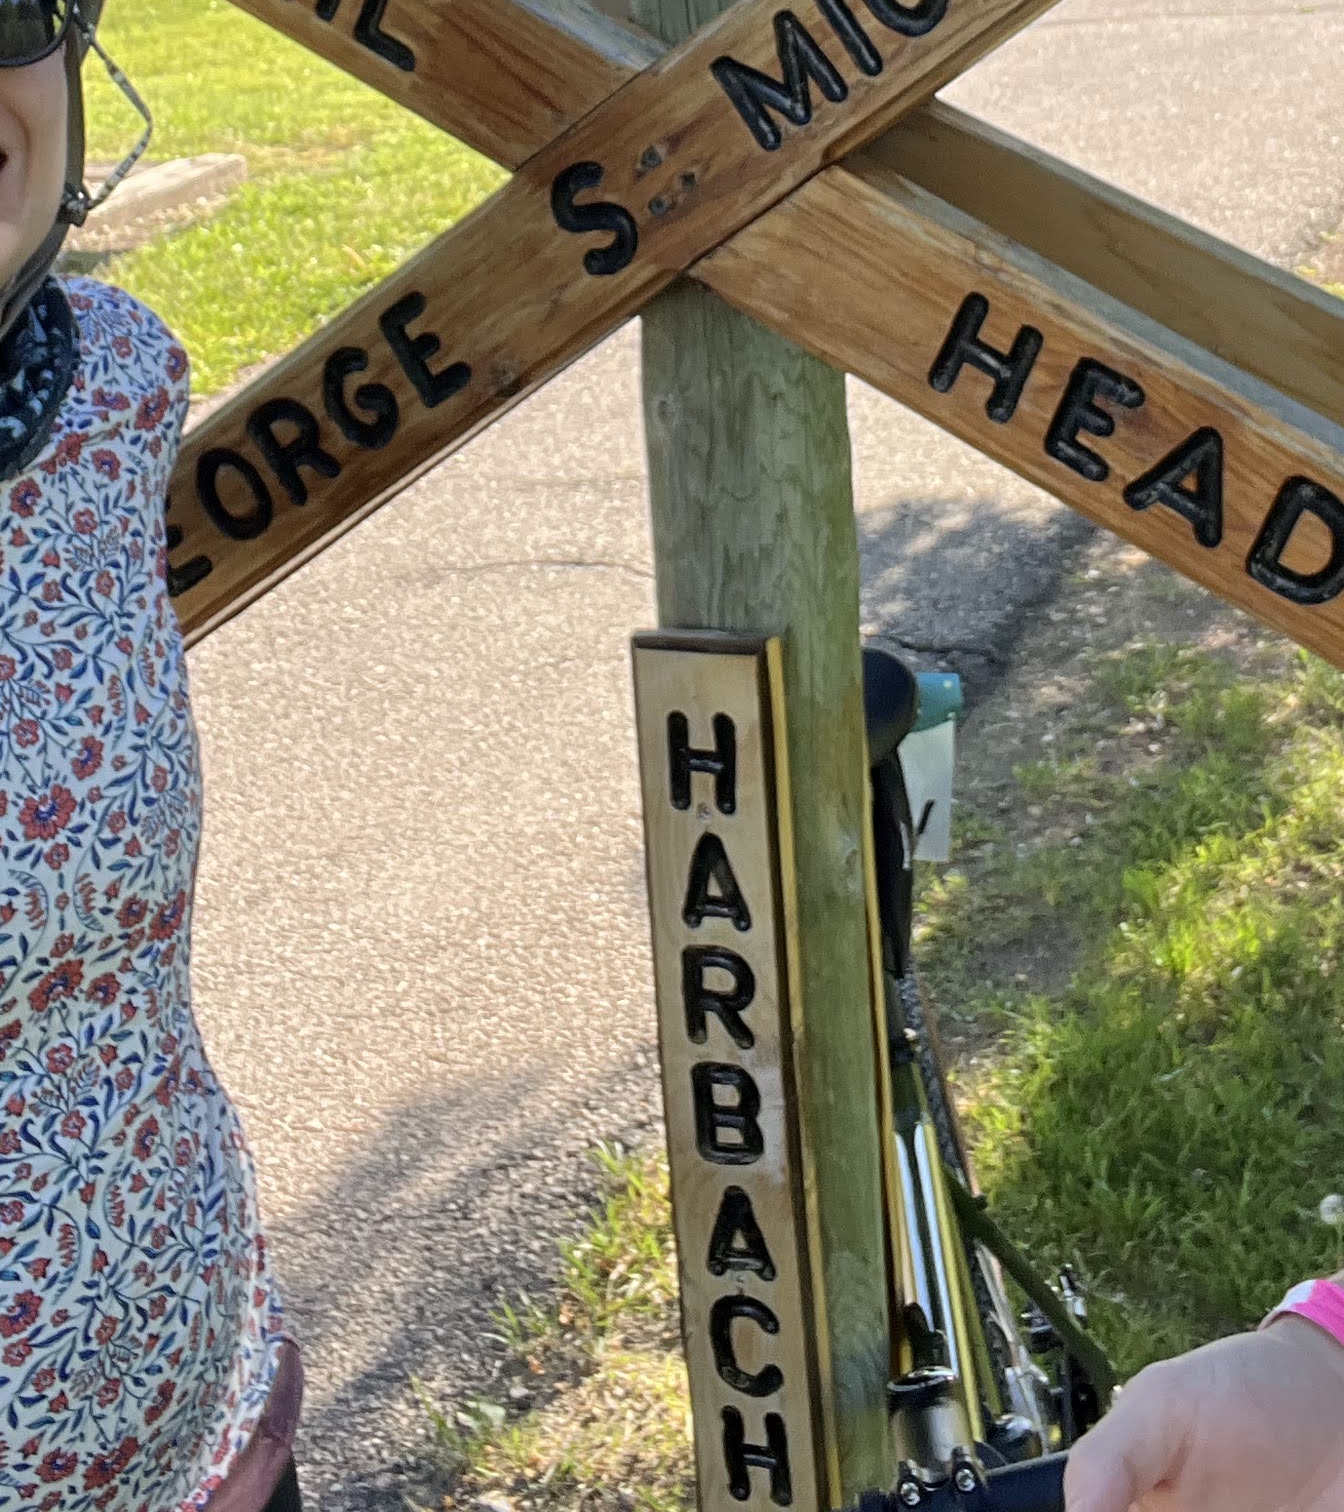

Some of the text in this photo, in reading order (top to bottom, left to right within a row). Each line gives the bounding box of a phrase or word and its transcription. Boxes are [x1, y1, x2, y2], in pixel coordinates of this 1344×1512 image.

[165, 291, 472, 598] ORGE
[551, 160, 638, 276] S
[666, 709, 794, 1507] HARBACH
